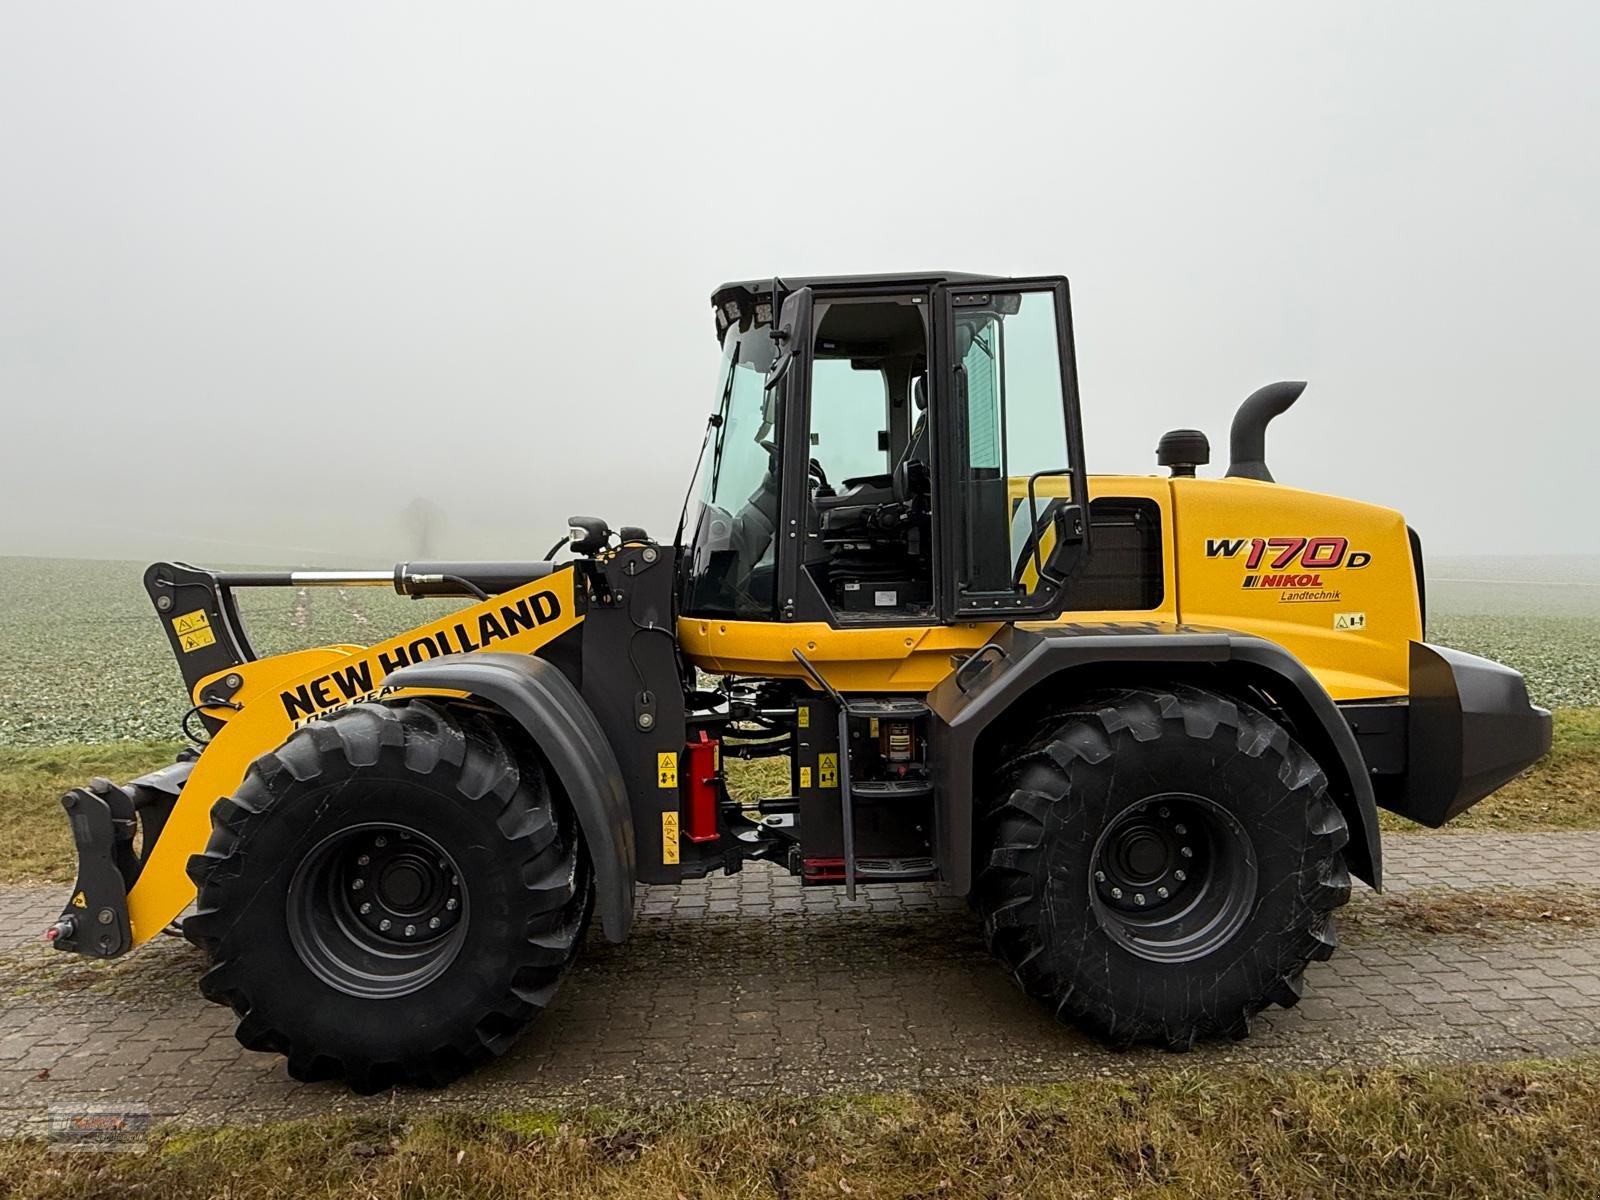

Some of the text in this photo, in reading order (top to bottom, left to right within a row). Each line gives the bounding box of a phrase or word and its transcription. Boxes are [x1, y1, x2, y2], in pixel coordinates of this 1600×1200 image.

[1260, 574, 1323, 587] NIKOL
[1280, 590, 1341, 601] Landtechnik
[280, 590, 561, 721] NEW HOLLAND
